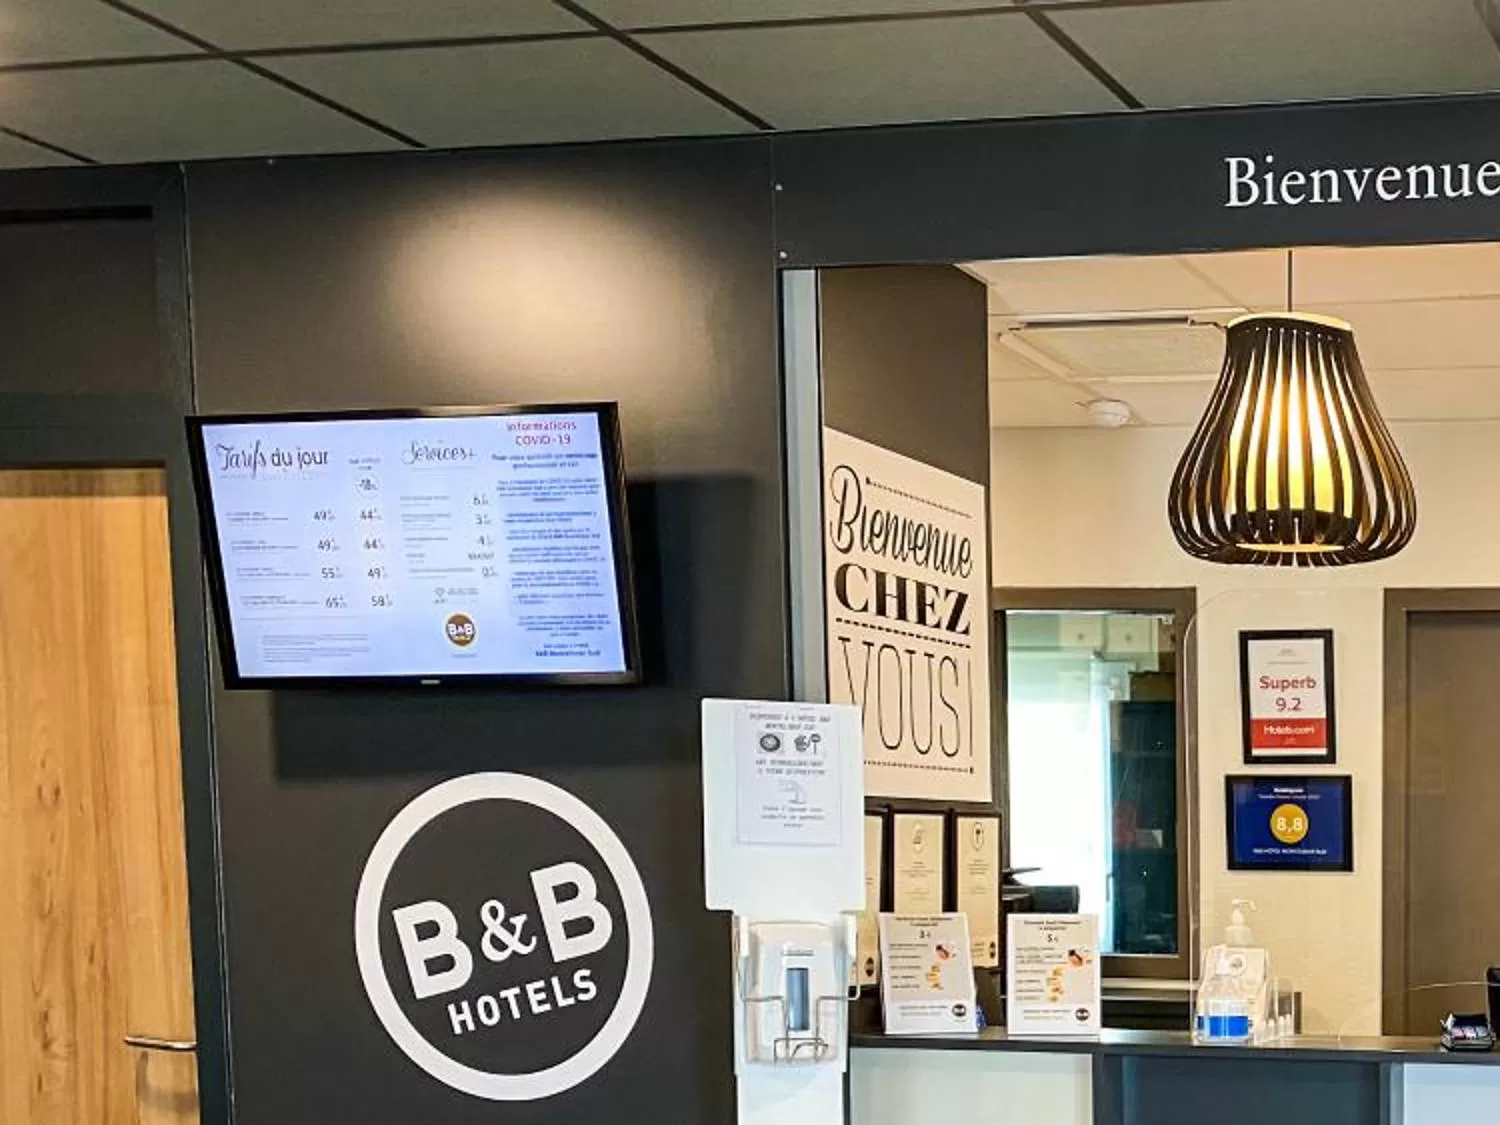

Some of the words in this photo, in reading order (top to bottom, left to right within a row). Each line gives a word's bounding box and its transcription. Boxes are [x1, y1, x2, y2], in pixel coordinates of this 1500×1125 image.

[215, 440, 266, 478] Tarifs
[271, 448, 293, 467] du
[297, 448, 328, 471] jour
[830, 465, 973, 579] Bienvenue
[834, 563, 972, 636] CHEZ
[1259, 675, 1317, 692] Superb
[1275, 697, 1302, 712] 9.2
[392, 861, 613, 999] B&B
[448, 969, 598, 1035] HOTELS
